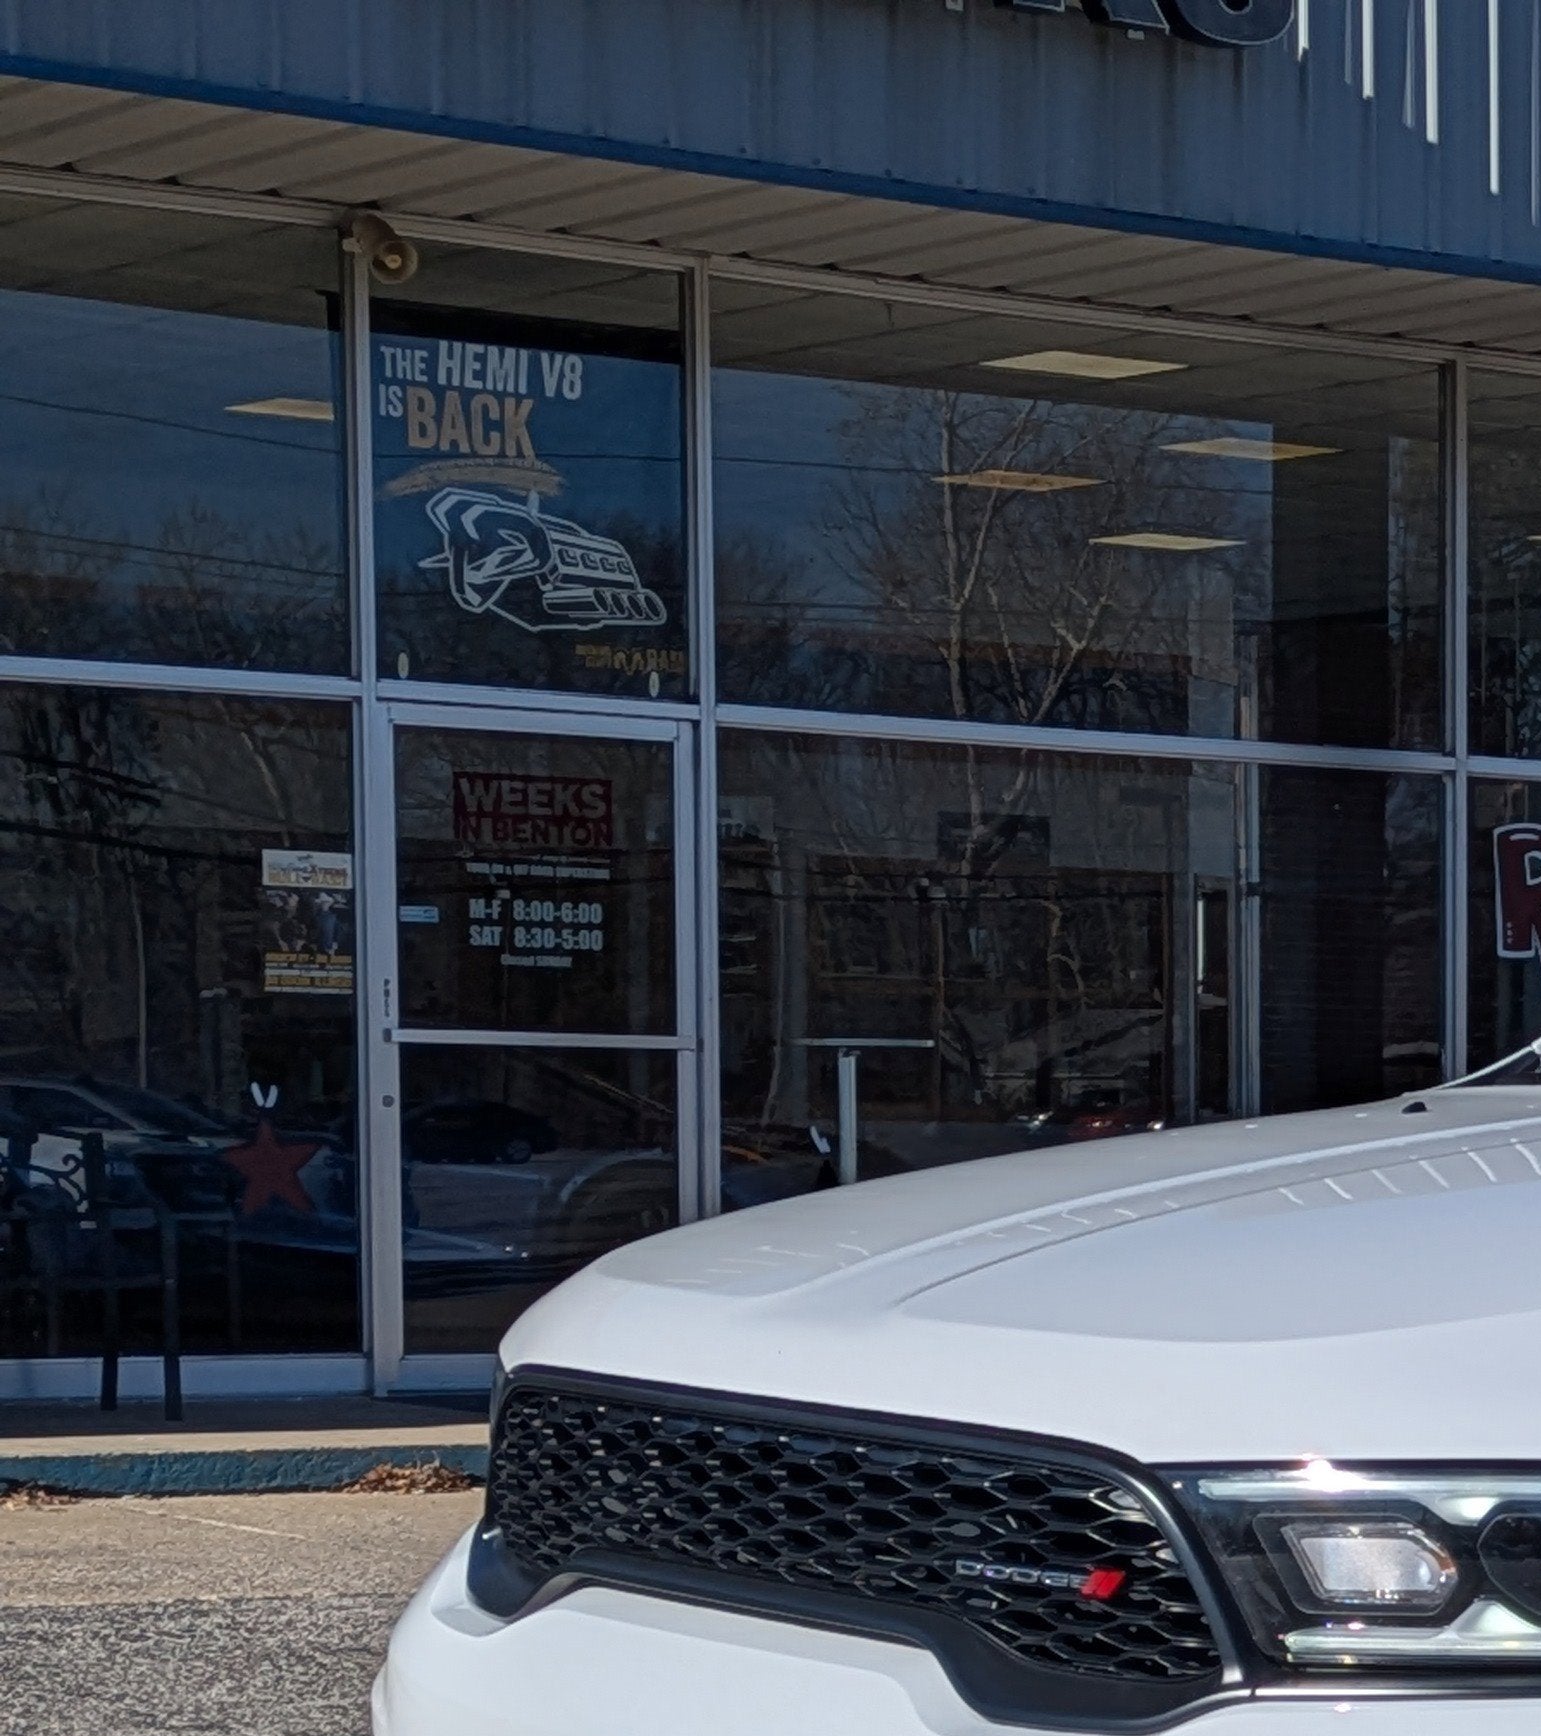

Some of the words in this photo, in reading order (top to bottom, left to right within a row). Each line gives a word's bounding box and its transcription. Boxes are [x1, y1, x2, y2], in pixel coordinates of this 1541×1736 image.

[380, 345, 429, 384] THE
[437, 340, 529, 395] HEMI
[540, 352, 584, 401] V8
[378, 384, 404, 418] IS
[406, 386, 537, 460] BACK
[457, 777, 607, 819] WEEKS
[492, 818, 614, 848] BENTON
[469, 898, 502, 920] M-F
[513, 899, 604, 925] 8:00-6:00
[469, 925, 503, 947] SAT
[513, 926, 604, 951] 8:30-5:00
[955, 1558, 1089, 1590] DODGE
